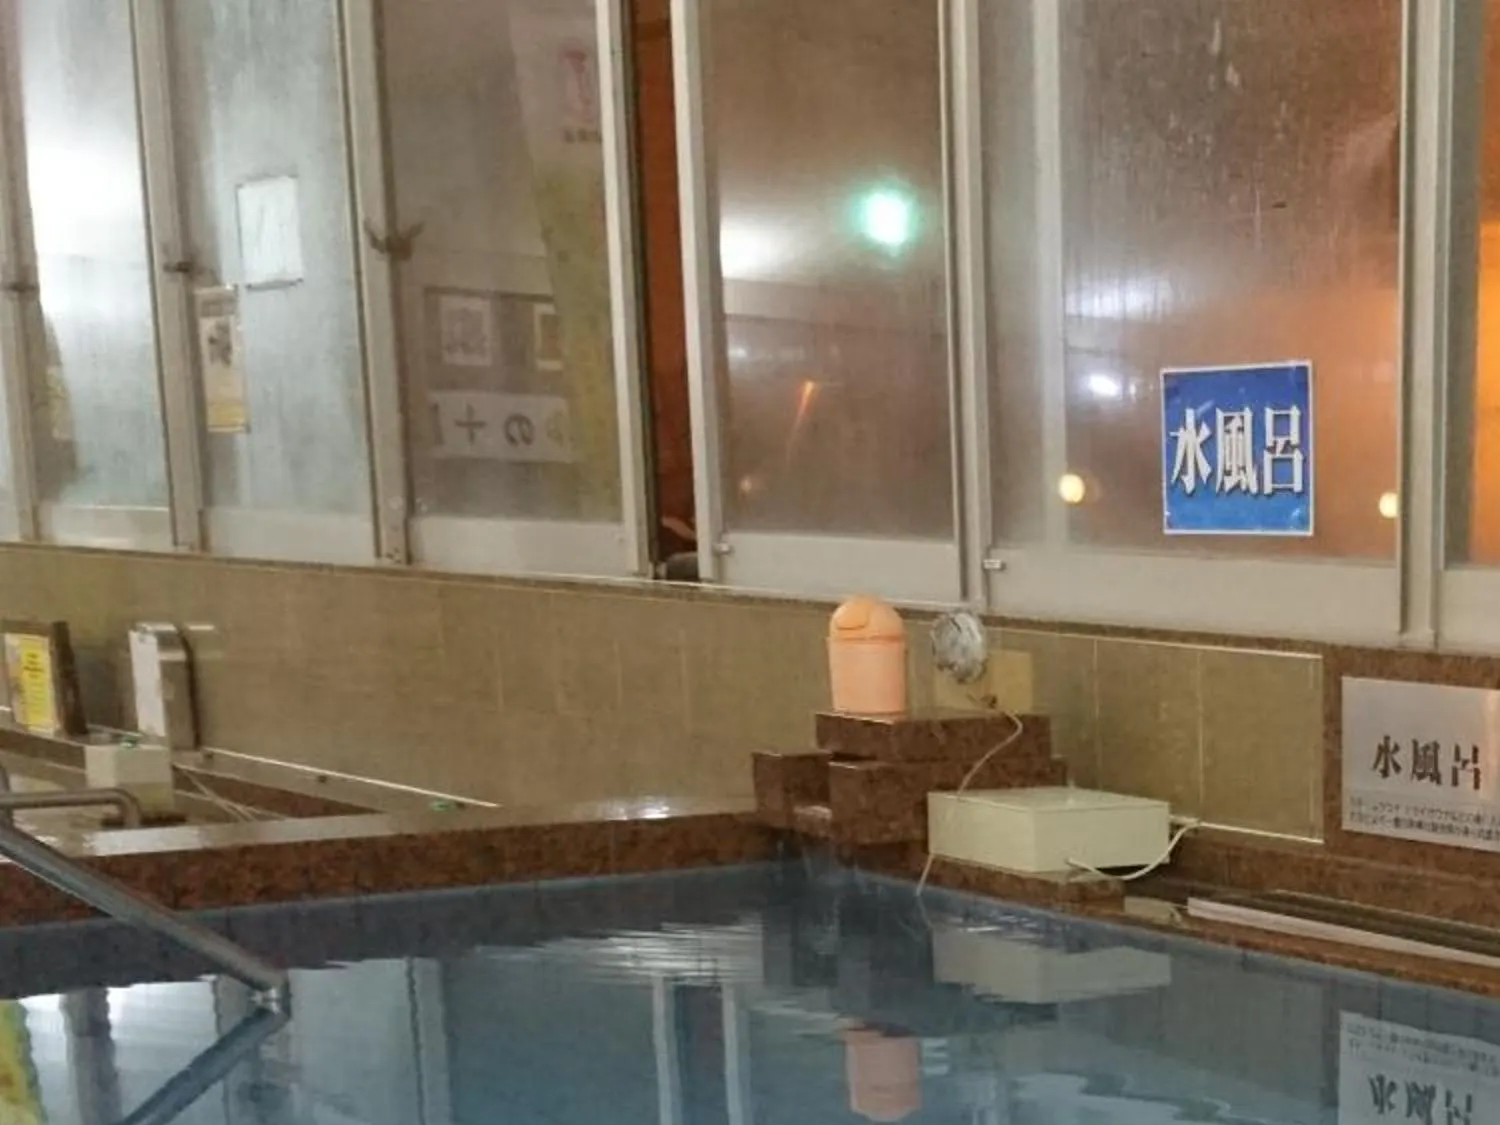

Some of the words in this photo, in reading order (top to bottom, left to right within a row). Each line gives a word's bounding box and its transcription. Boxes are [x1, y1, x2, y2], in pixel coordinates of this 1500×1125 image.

[1169, 404, 1304, 496] 水風呂
[1372, 734, 1481, 791] 水風呂
